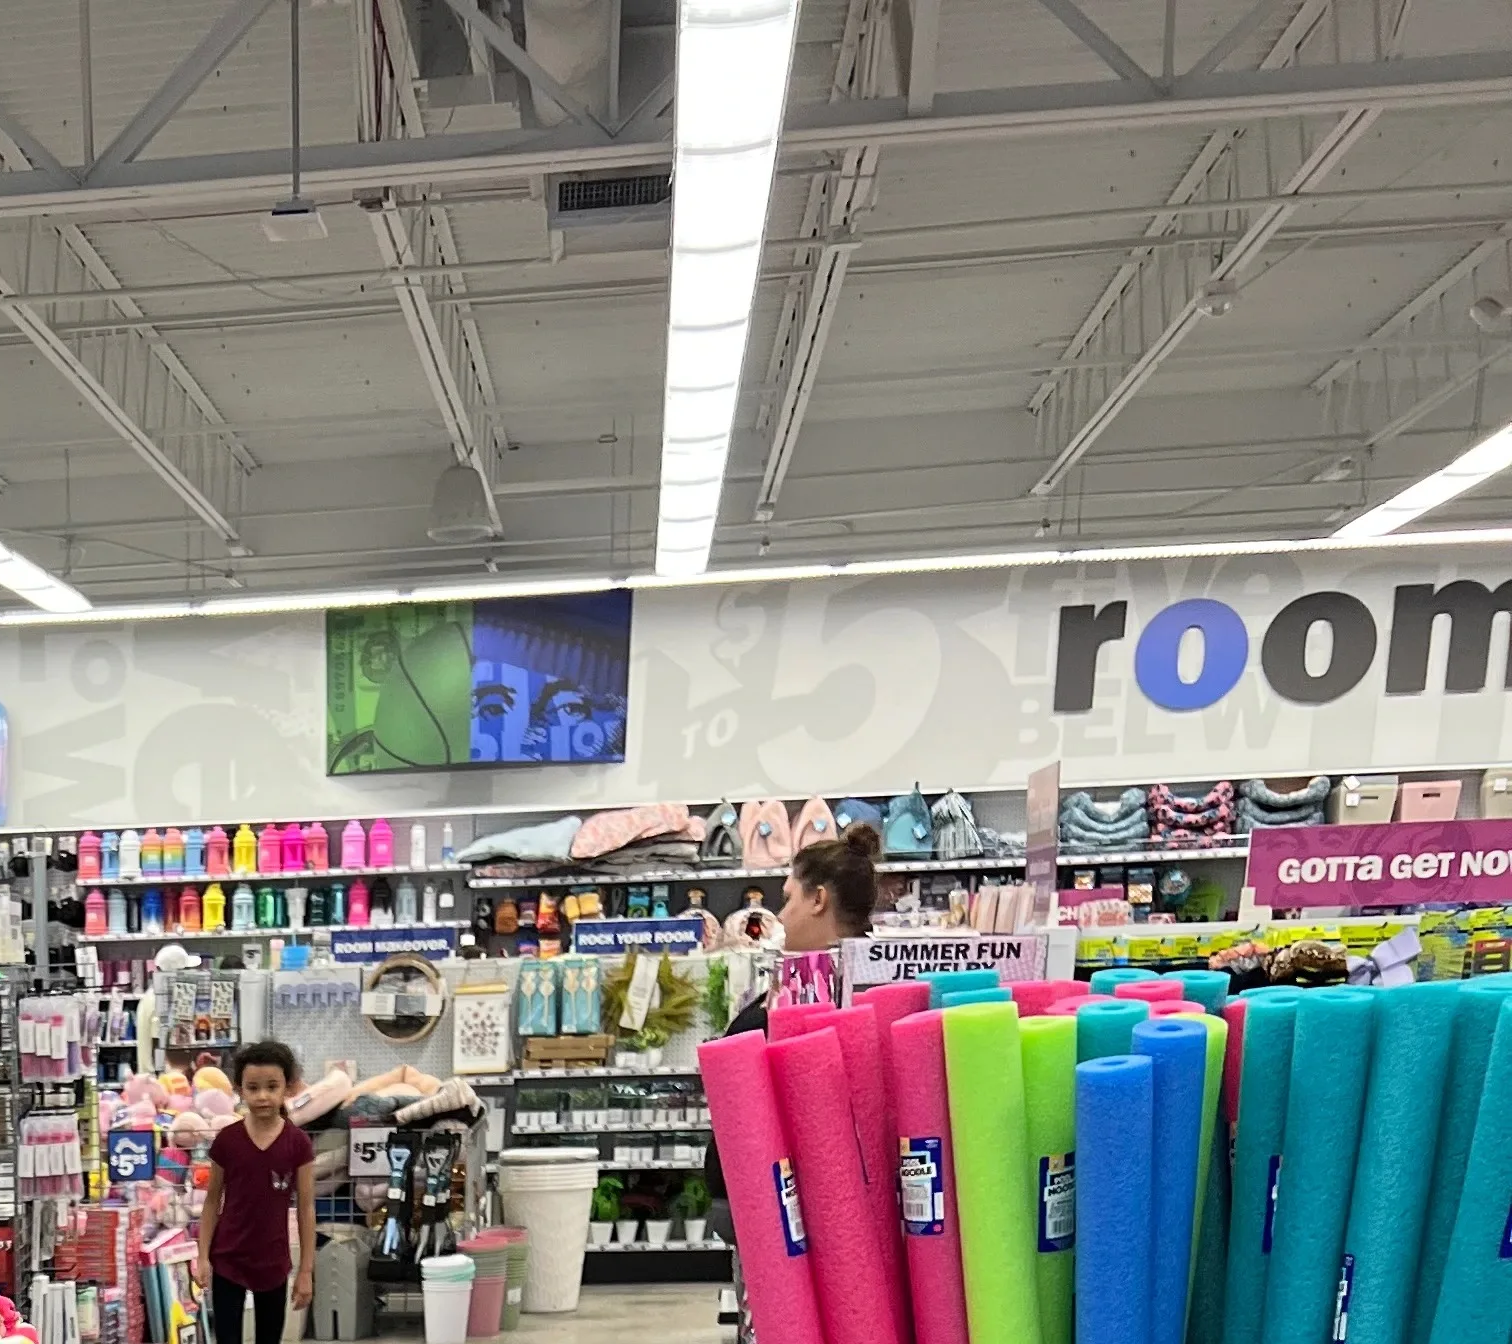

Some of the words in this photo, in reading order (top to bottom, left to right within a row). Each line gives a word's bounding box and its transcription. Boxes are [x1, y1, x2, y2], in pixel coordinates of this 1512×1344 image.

[1458, 847, 1512, 877] NO
[334, 939, 372, 953] ROOM
[579, 933, 614, 946] ROCK
[617, 932, 652, 945] YOUR
[869, 942, 971, 961] SUMMER
[977, 942, 1022, 959] FUN
